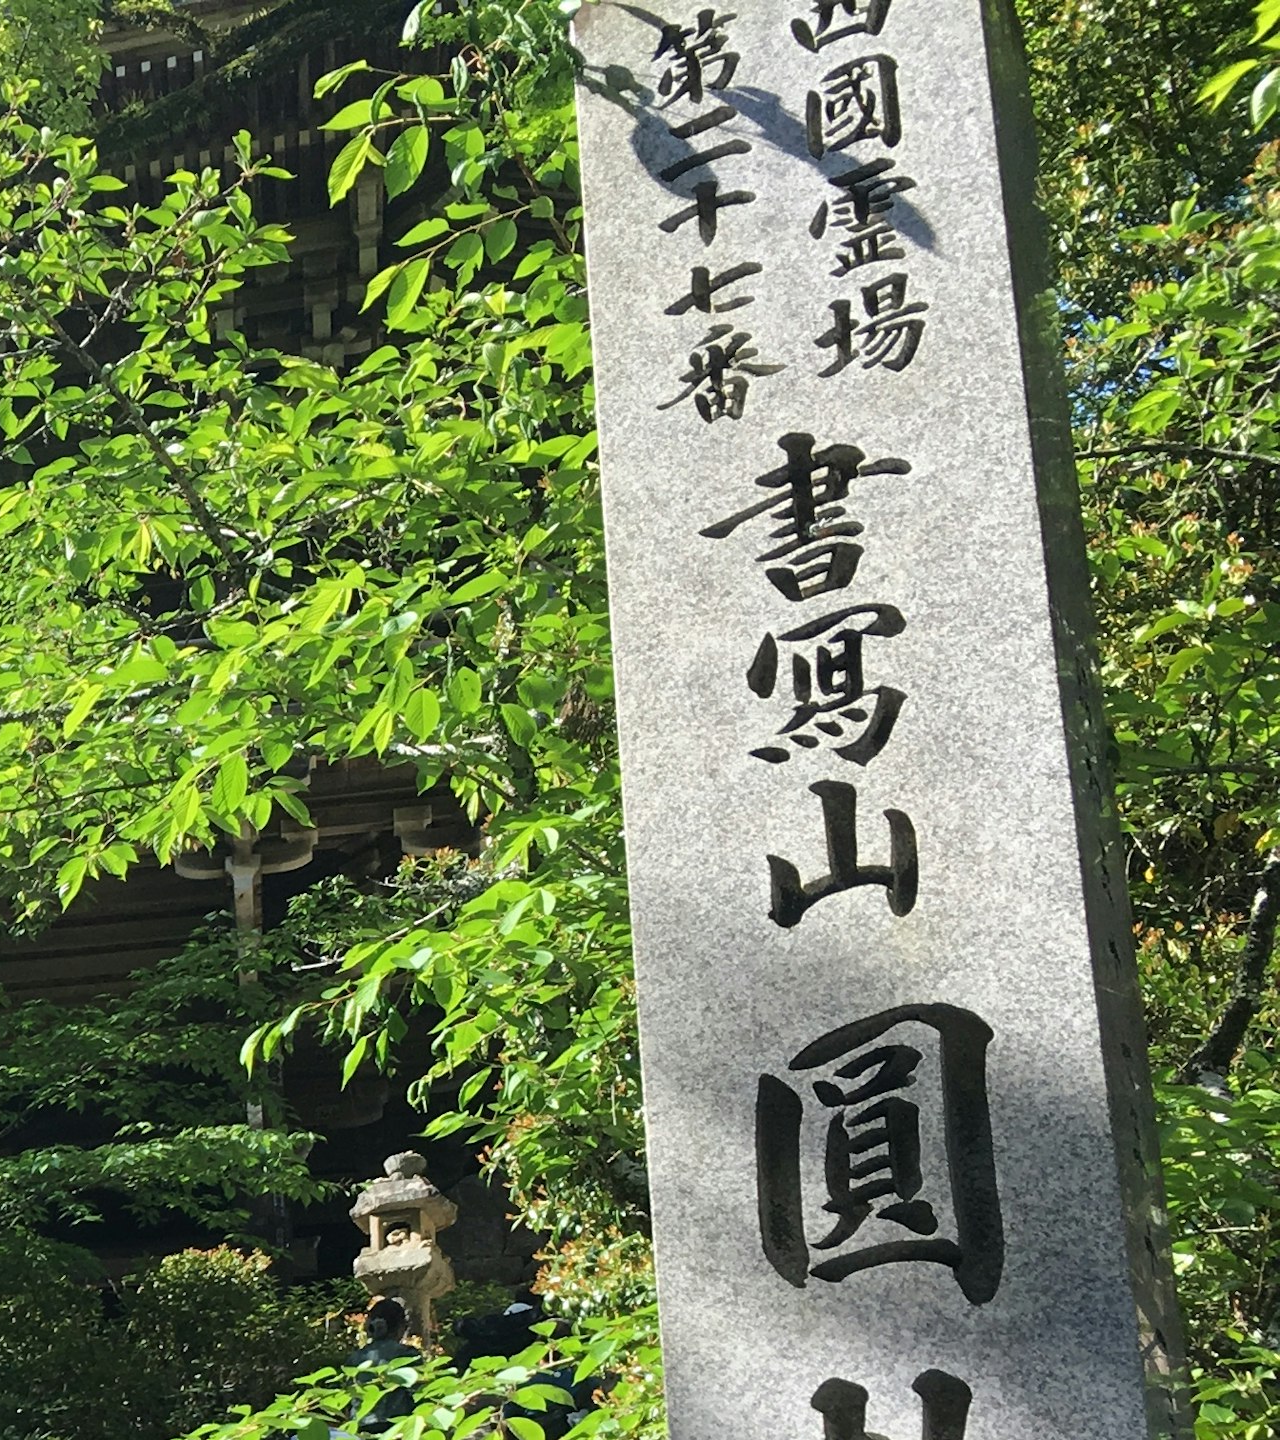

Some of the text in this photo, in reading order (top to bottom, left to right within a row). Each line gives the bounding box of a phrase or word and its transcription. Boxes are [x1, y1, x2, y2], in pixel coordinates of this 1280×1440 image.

[652, 10, 787, 424] 第二十七番
